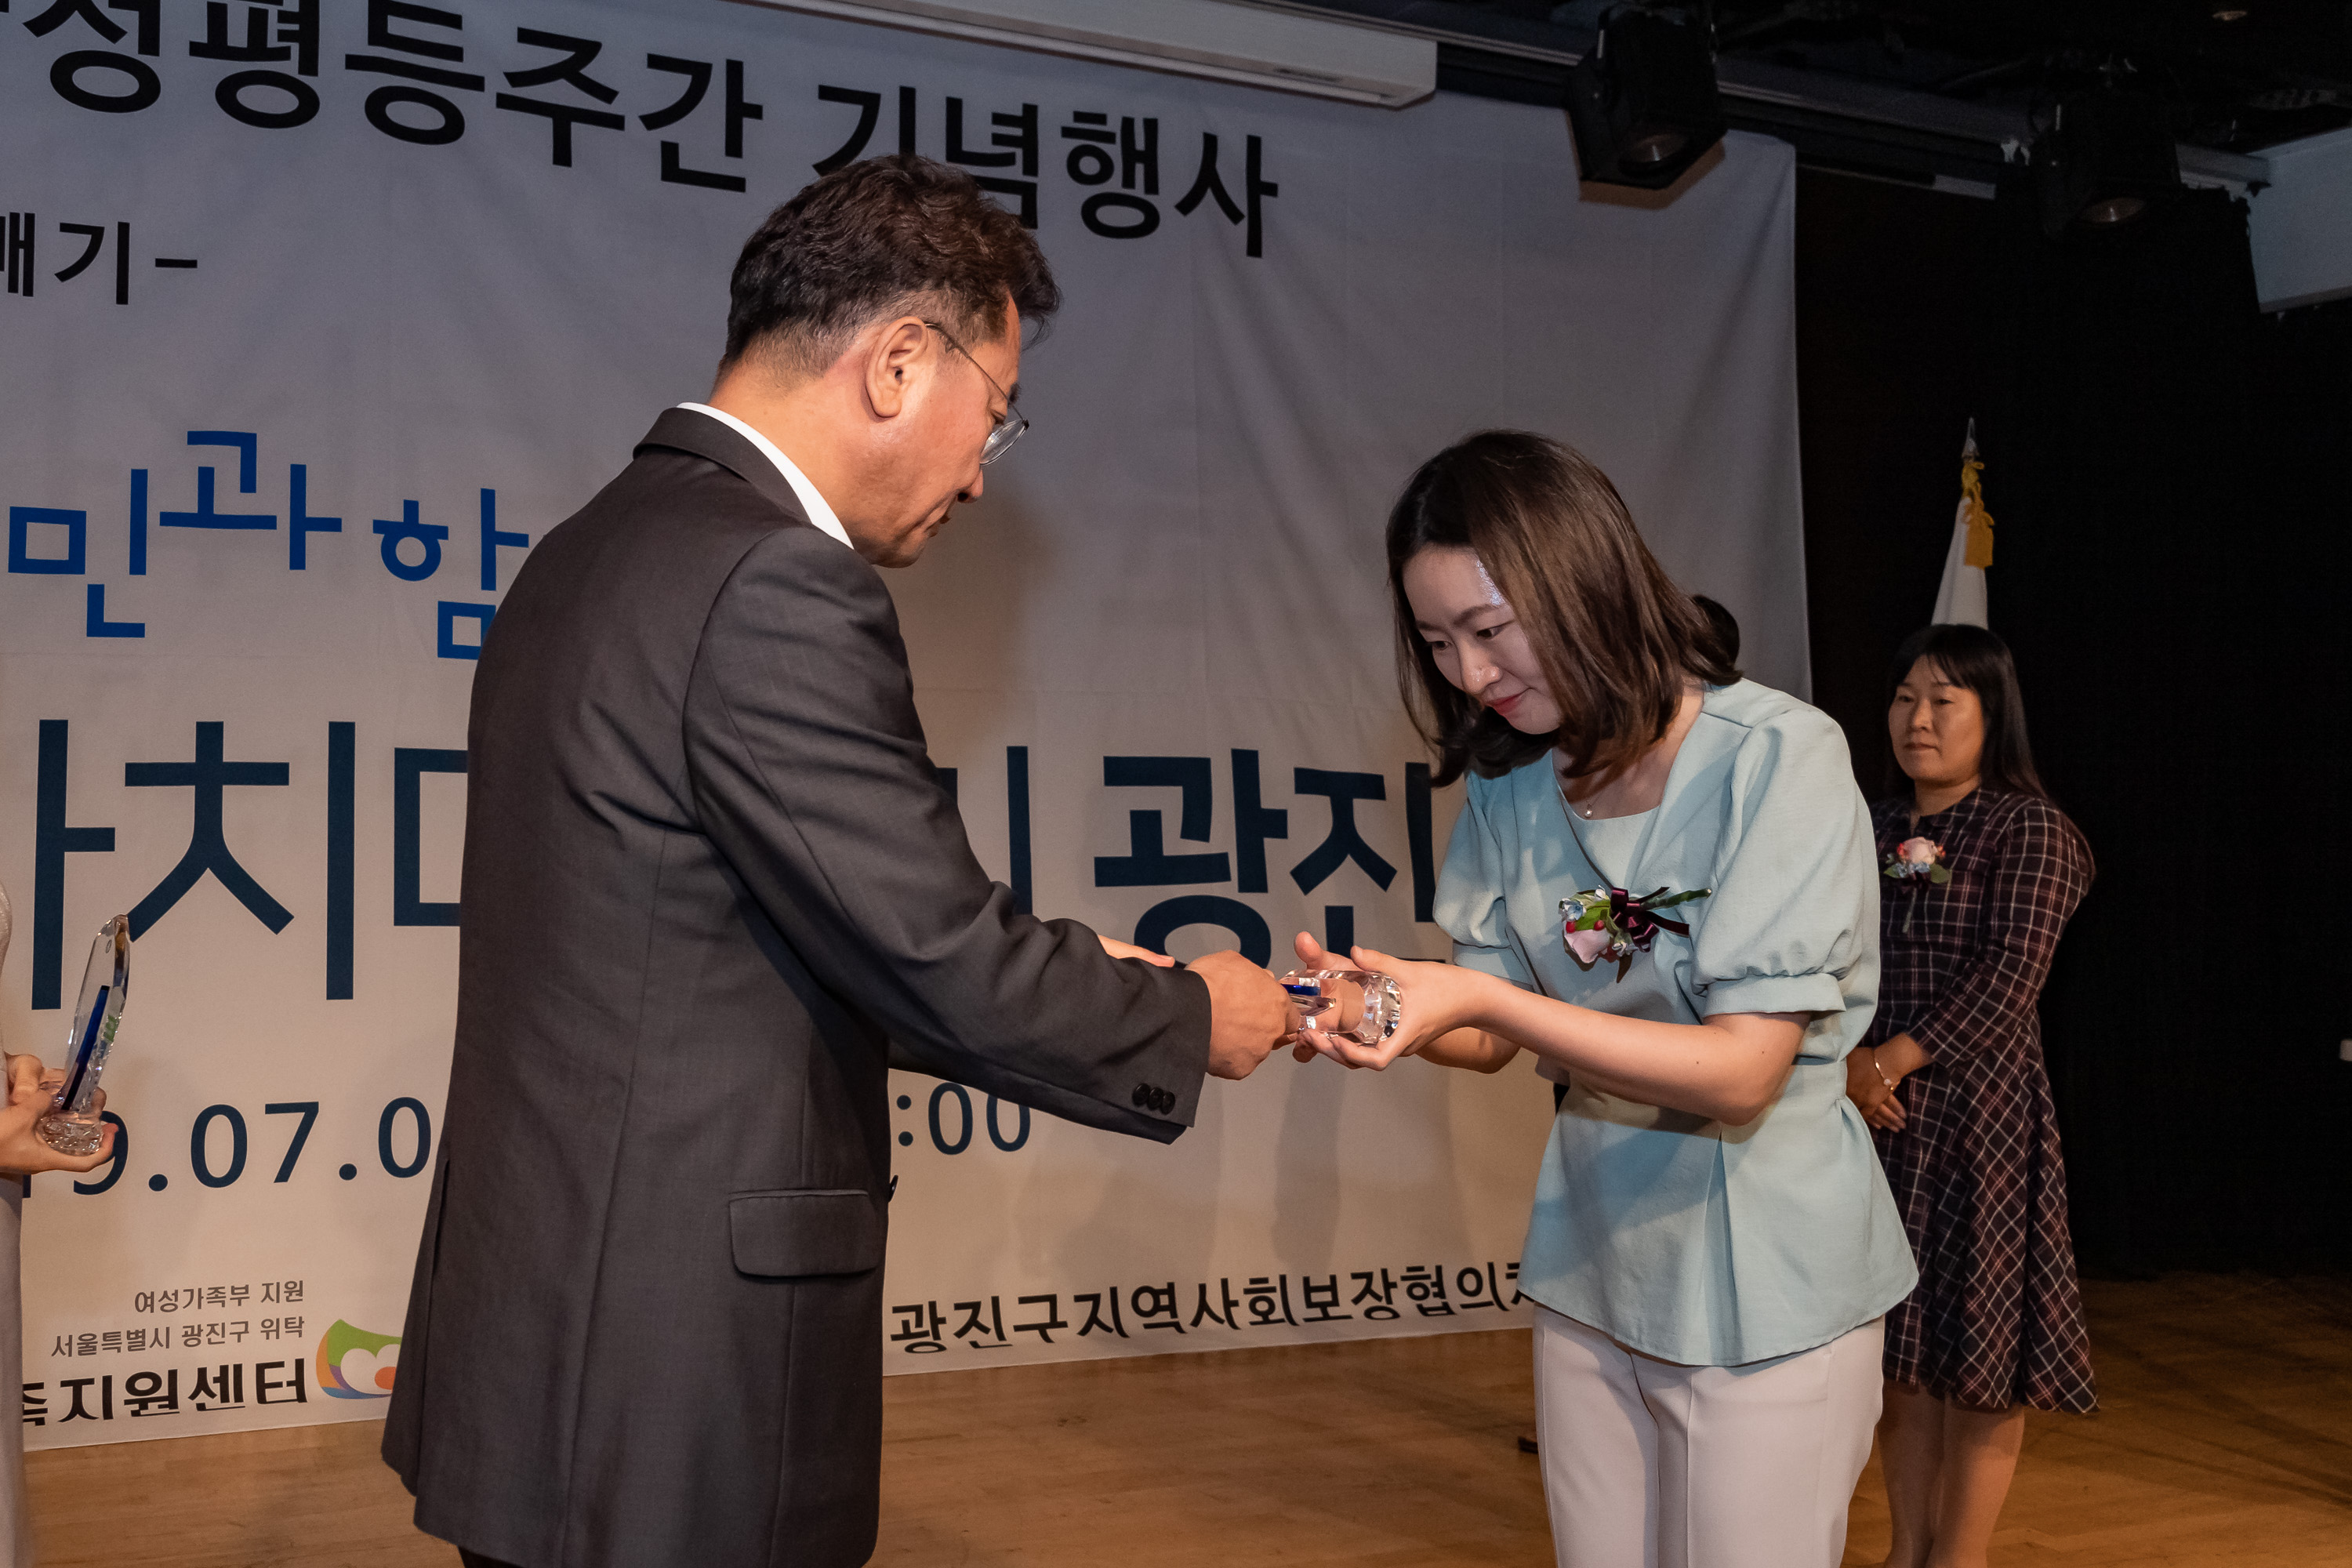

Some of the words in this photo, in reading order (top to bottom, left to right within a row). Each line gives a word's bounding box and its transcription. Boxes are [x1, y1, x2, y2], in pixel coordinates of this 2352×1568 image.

[0, 0, 763, 193] 성평등주간
[23, 1097, 431, 1198] 9.07.0
[135, 1284, 250, 1313] 여성가족부
[260, 1279, 304, 1303] 지원
[51, 1327, 171, 1358] 서울특별시
[181, 1320, 250, 1347] 광진구
[260, 1316, 305, 1340] 위탁
